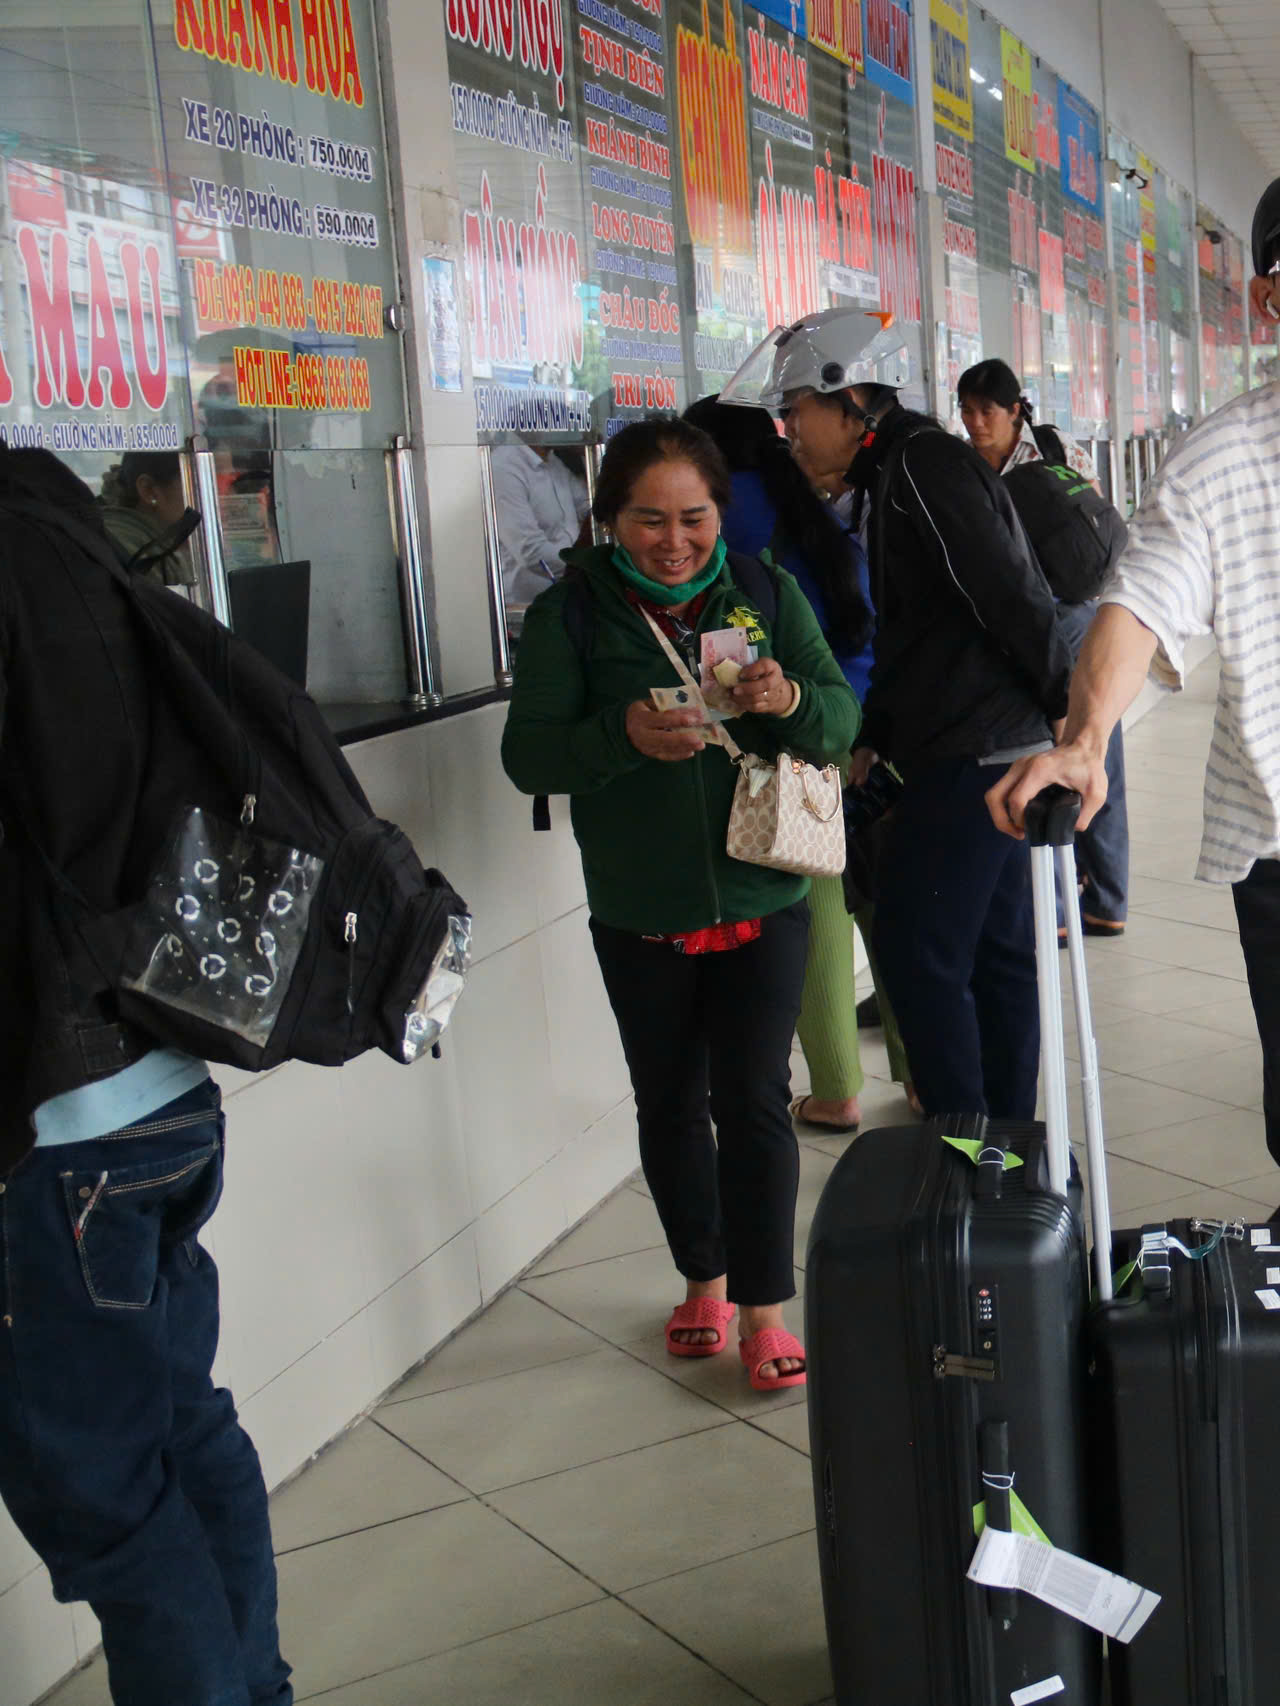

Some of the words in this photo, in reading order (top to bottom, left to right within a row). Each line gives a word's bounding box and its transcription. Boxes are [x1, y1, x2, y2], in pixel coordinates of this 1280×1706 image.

[580, 24, 625, 79] TỊNH
[626, 48, 665, 99] BIÊN
[182, 98, 212, 145] XE
[213, 107, 236, 151] 20
[238, 109, 298, 167] PHÒNG
[586, 116, 638, 168] KHÁNH
[638, 130, 671, 180] BÌNH
[189, 177, 219, 221] XE
[220, 184, 245, 228] 32
[244, 184, 304, 239] PHÒNG
[592, 201, 630, 244] LONG
[631, 211, 675, 257] XUYÊN
[464, 170, 521, 367] TÂN
[17, 226, 168, 410] MAU
[257, 268, 281, 328] 449
[281, 272, 308, 331] 883
[312, 276, 343, 335] 0915
[599, 284, 646, 332] CHÂU
[648, 286, 680, 336] ĐỐC
[327, 355, 350, 410] 883
[349, 356, 372, 411] 868
[612, 371, 643, 408] TRI
[645, 366, 678, 410] TÔN
[52, 416, 98, 450] GIƯỜNG
[129, 423, 178, 449] 185.000đ
